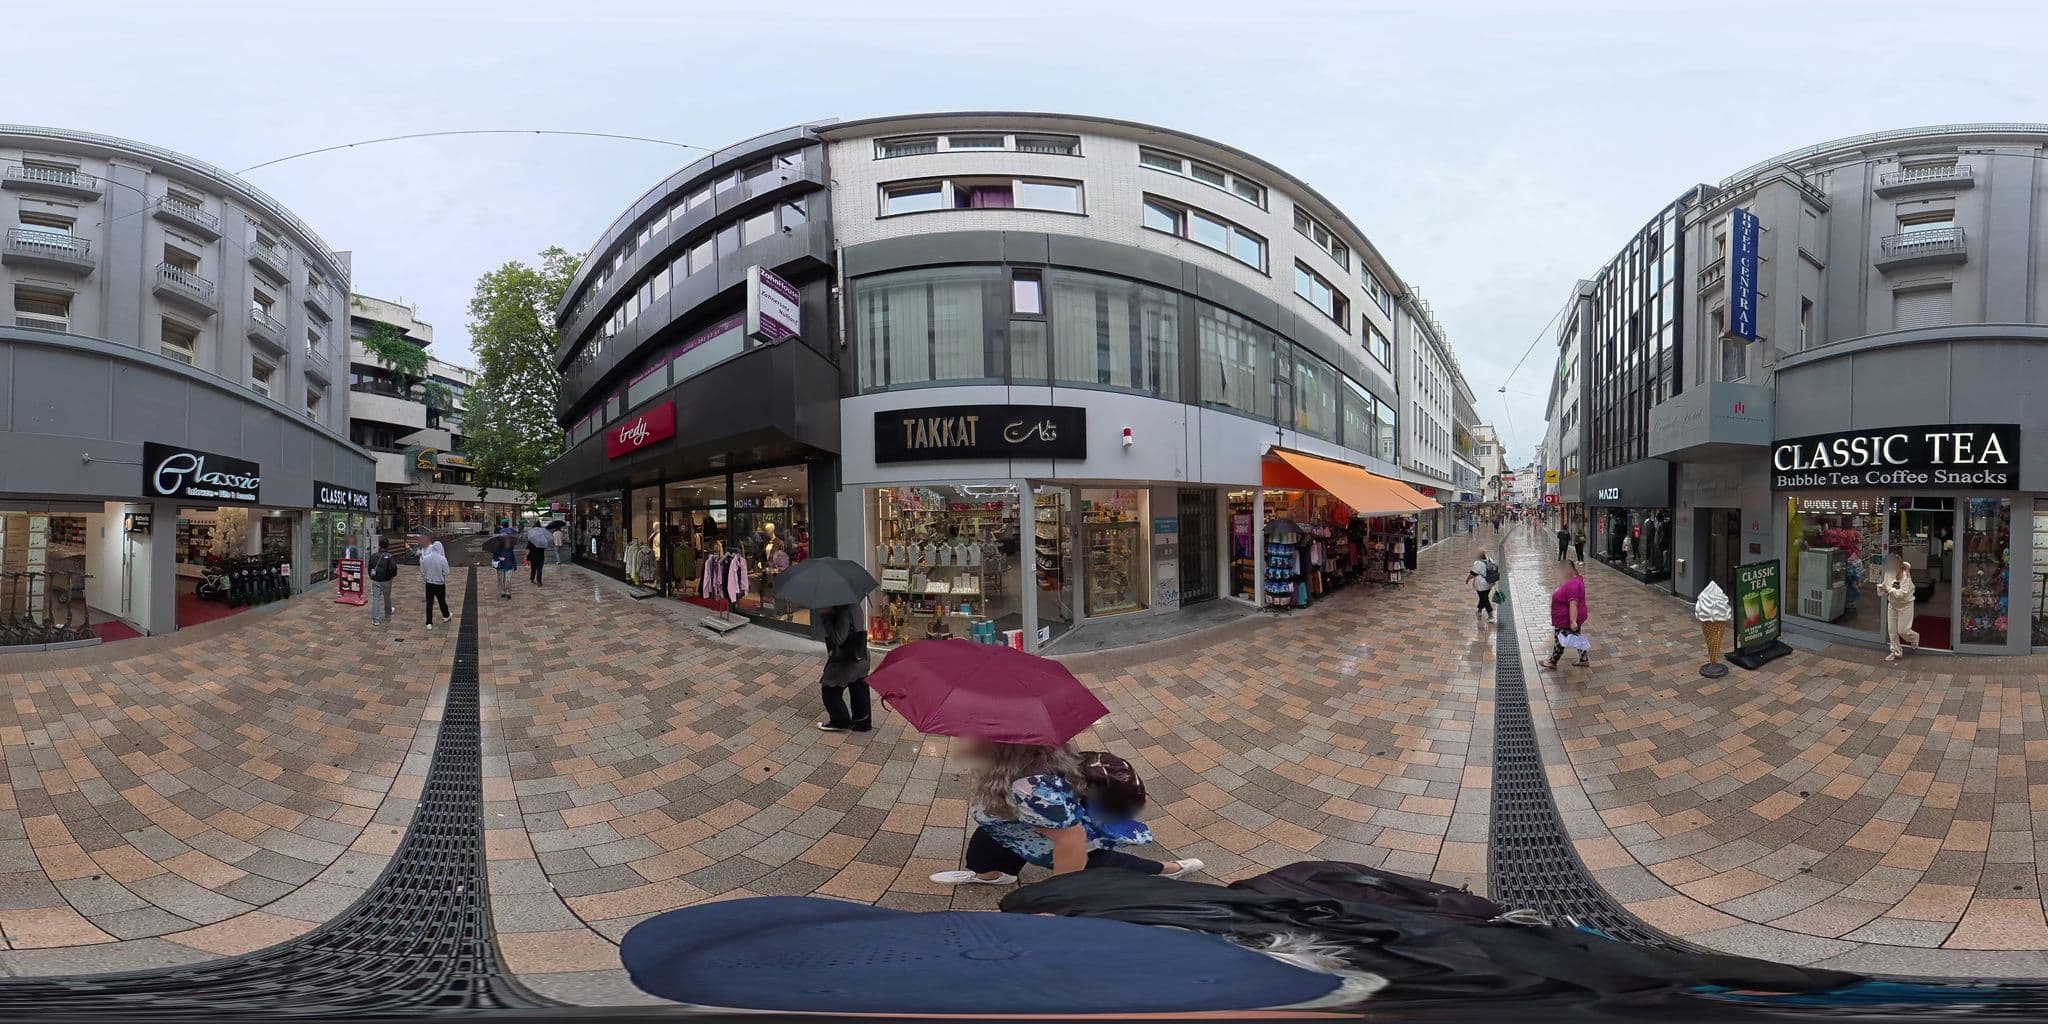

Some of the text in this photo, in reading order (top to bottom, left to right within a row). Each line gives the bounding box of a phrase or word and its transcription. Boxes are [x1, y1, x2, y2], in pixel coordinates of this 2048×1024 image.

[1739, 212, 1751, 336] HOTEL CENTRAL
[619, 417, 650, 446] tredy
[903, 415, 979, 449] TAKKAT
[1774, 432, 2009, 471] CLASSIC TEA
[153, 453, 260, 495] Classic
[1777, 469, 2008, 487] Bubble Tea Coffee Snacks
[320, 487, 347, 506] CLASSIC
[353, 493, 369, 507] PHONE
[1598, 487, 1620, 500] MAZO
[1840, 500, 1859, 510] TEA
[1742, 566, 1775, 582] CLASSIC
[1750, 578, 1768, 590] TEA
